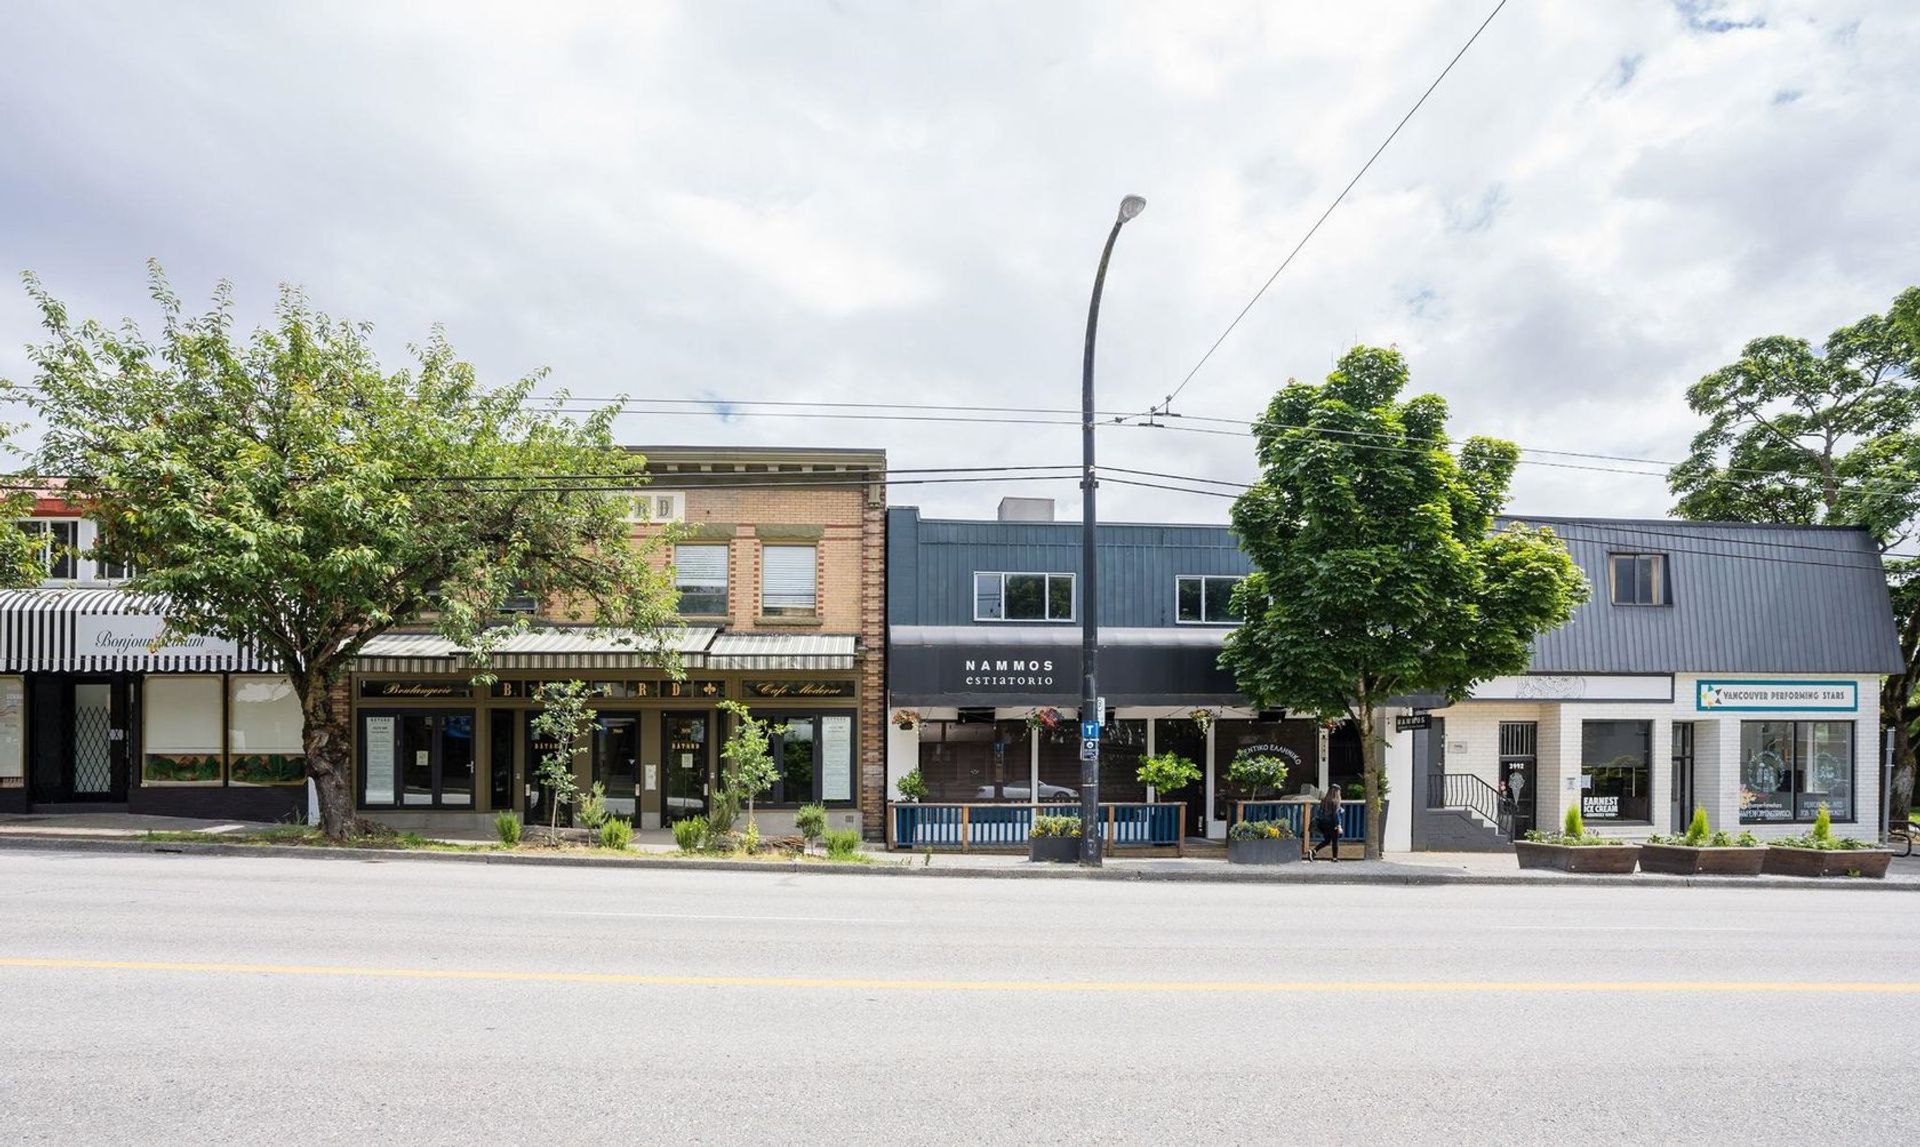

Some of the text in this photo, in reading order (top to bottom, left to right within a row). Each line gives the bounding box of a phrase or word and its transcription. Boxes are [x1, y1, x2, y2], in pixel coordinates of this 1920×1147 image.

[95, 630, 152, 654] Bonjour
[965, 660, 1052, 671] NAMMOS
[383, 683, 453, 697] Boulangerie
[1723, 691, 1845, 700] VANCOUVER PERFORMING STARS
[1086, 725, 1094, 735] T
[1583, 797, 1619, 805] EARNEST
